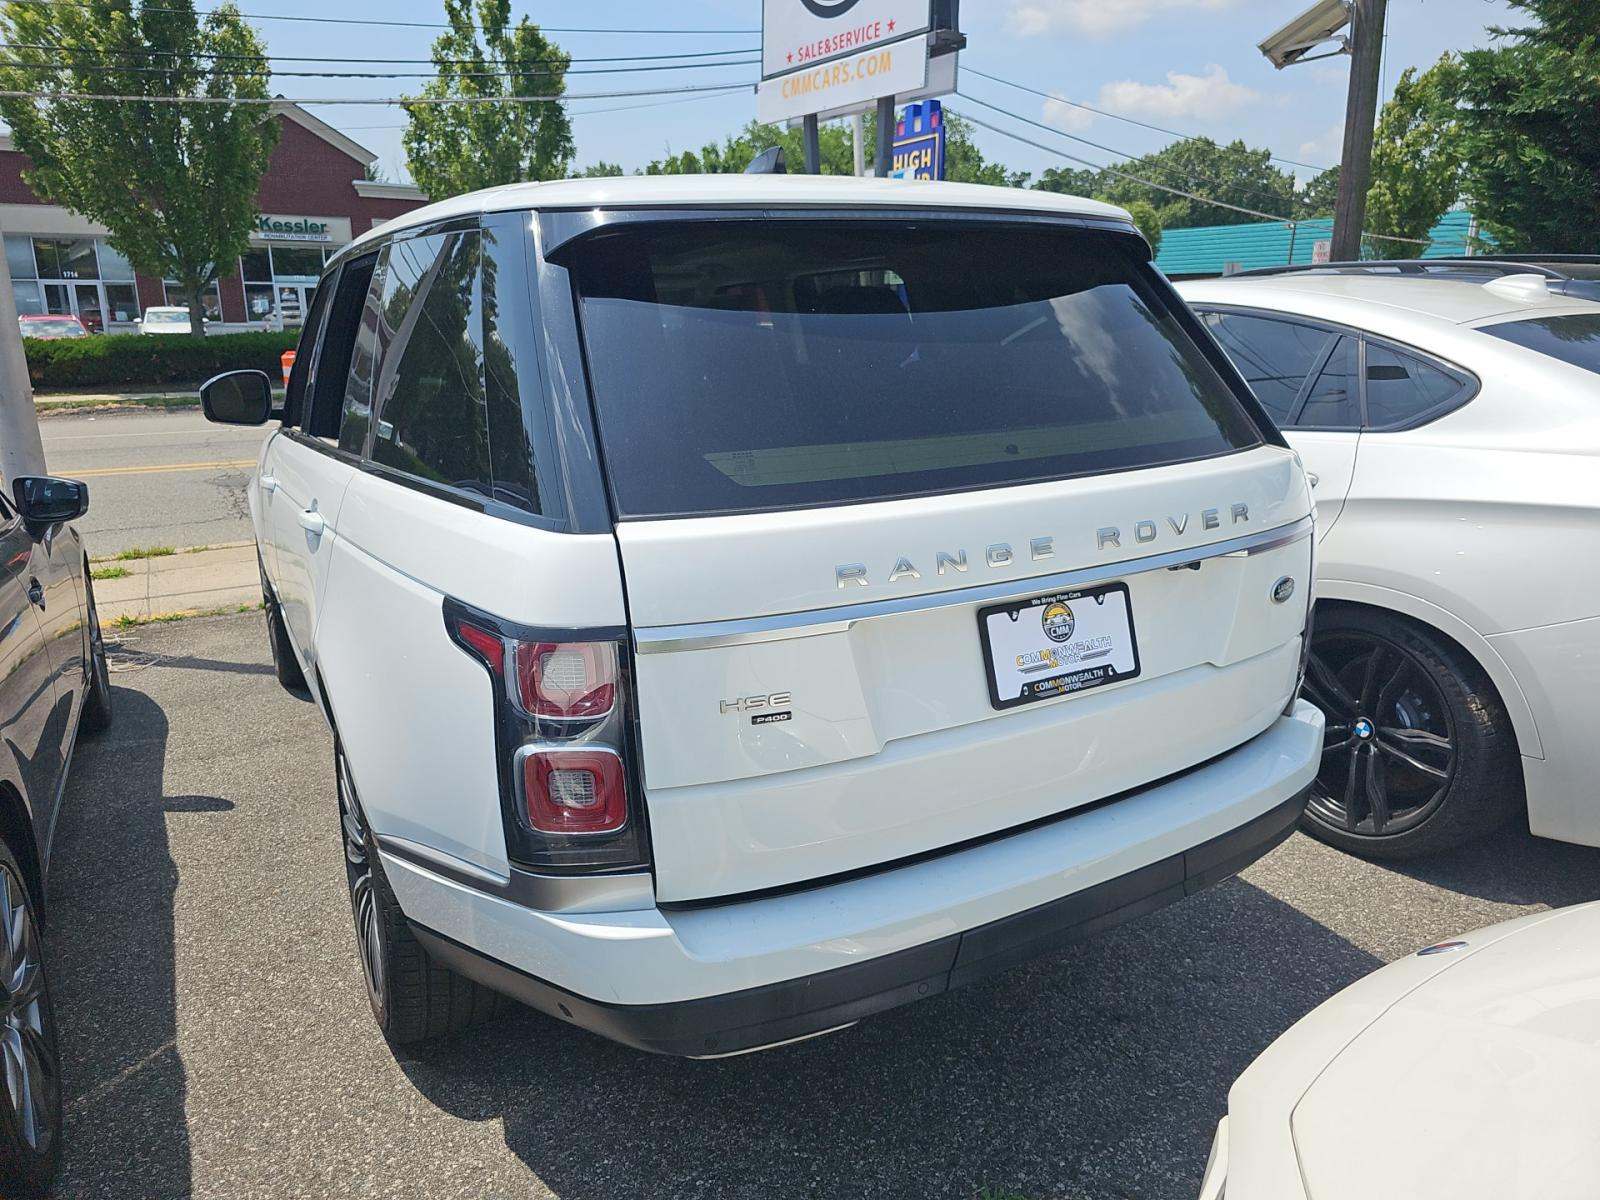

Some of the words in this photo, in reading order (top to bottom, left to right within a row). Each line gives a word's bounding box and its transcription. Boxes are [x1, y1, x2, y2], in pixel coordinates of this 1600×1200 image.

[798, 21, 881, 62] SALE&SERVICE
[781, 51, 892, 99] CMMCARS.COM
[893, 148, 931, 171] HIGH
[259, 216, 327, 233] Kessler
[835, 536, 1056, 590] RANGE
[1096, 502, 1250, 551] ROVER
[1041, 596, 1056, 604] Bring
[1050, 625, 1070, 636] CMM
[1016, 635, 1113, 667] COMMONWEALTH
[1049, 654, 1081, 668] MOTOR
[1034, 669, 1104, 692] COMMONWEALTH
[1058, 681, 1082, 693] MOTOR
[720, 691, 792, 714] HSE
[757, 714, 788, 723] P400
